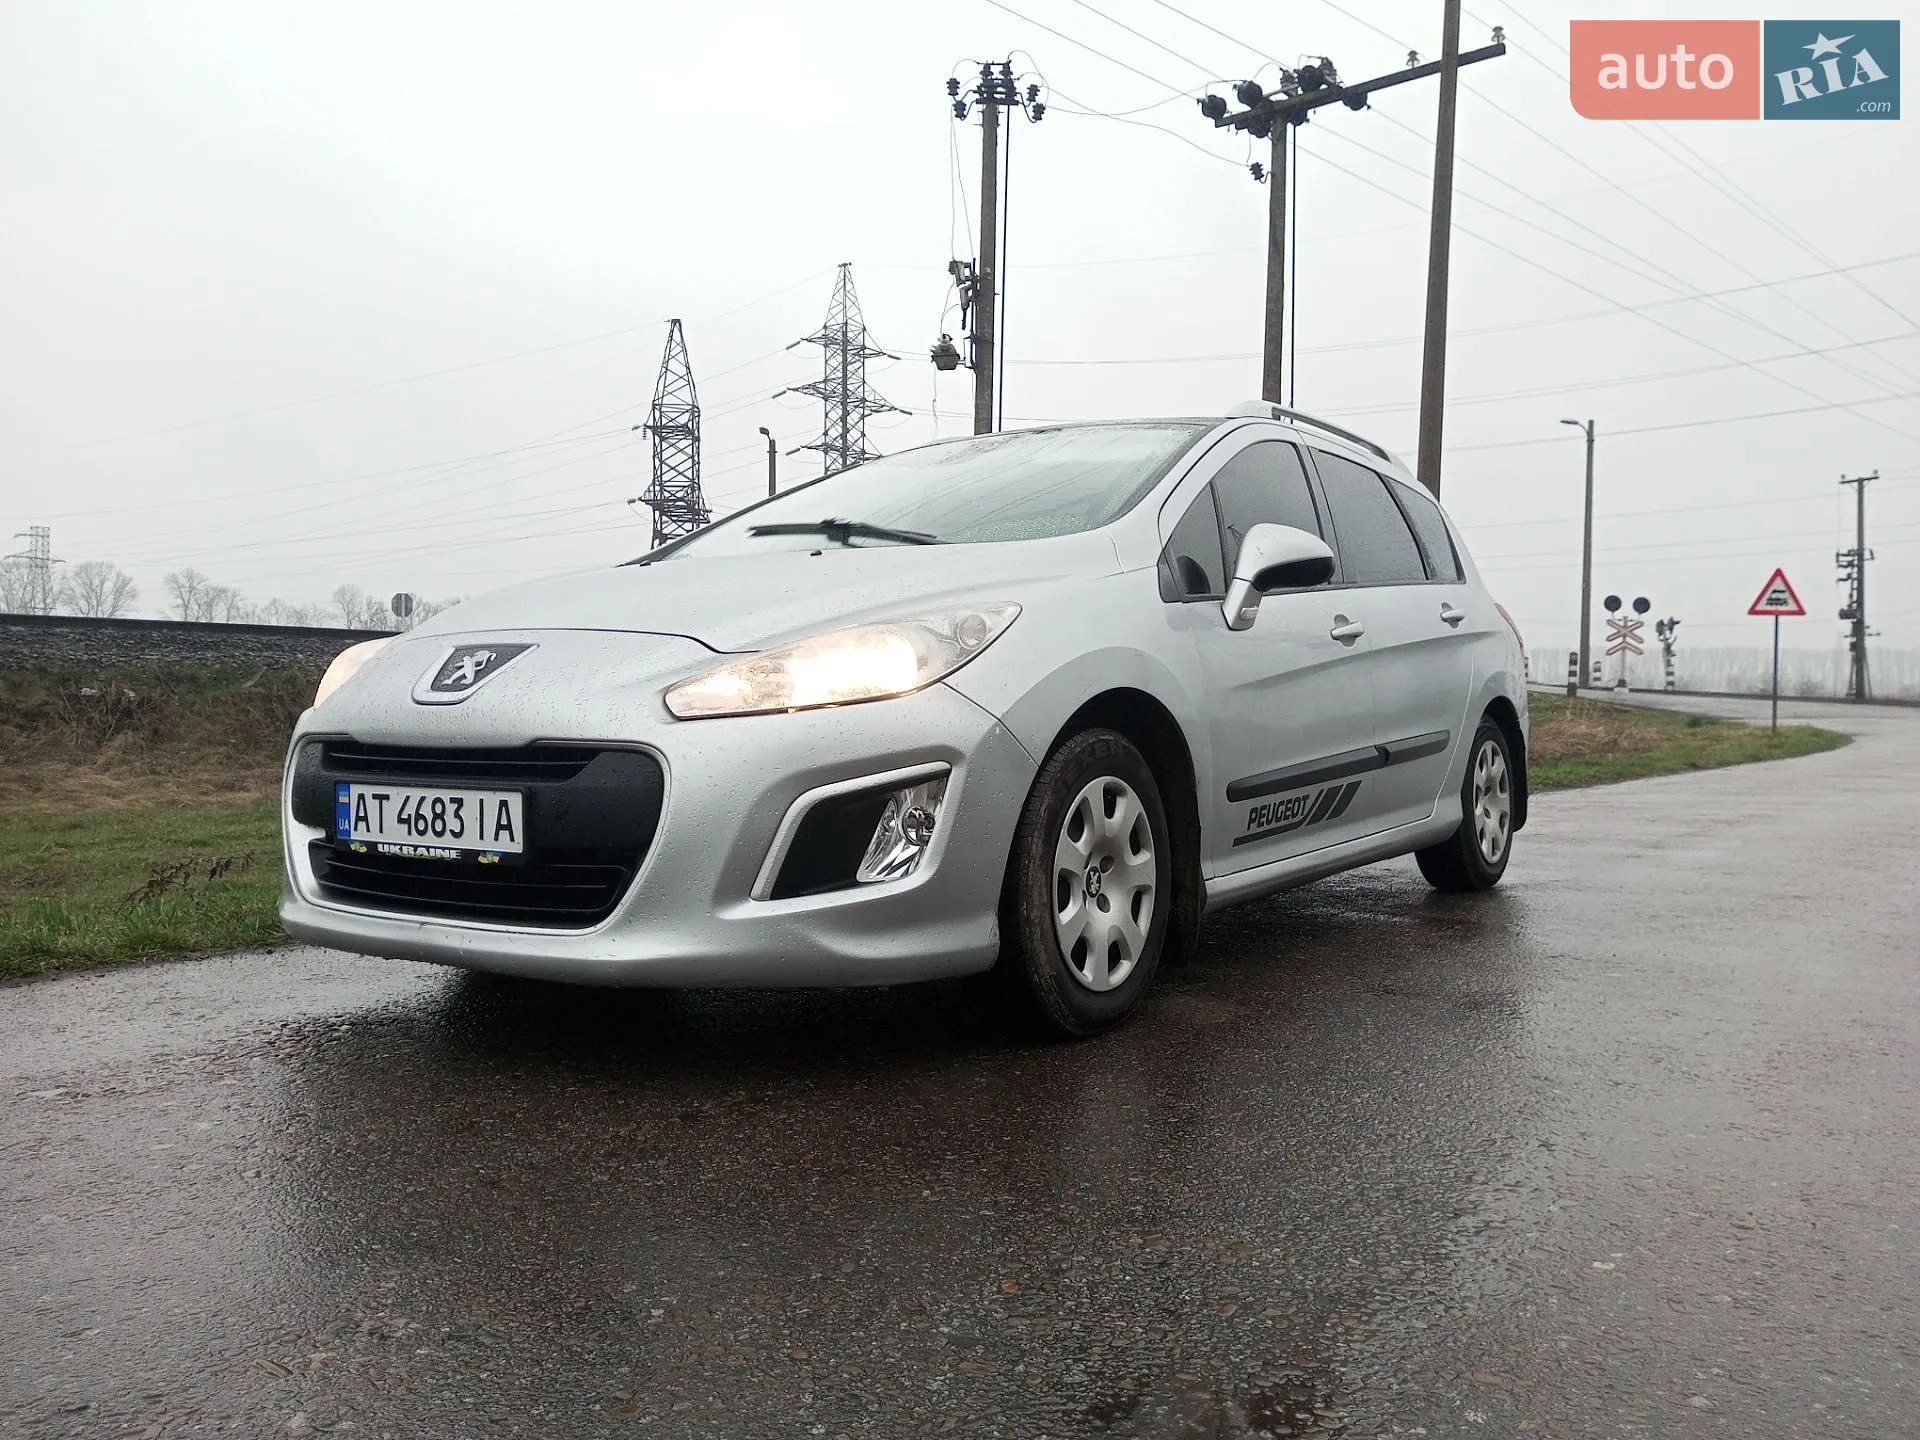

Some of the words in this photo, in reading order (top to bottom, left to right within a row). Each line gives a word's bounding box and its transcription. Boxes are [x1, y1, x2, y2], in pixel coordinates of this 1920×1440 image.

[338, 818, 350, 831] UA
[353, 792, 391, 834] AT
[396, 794, 465, 839] 4683
[478, 798, 516, 843] IA
[1246, 794, 1310, 832] PEUGEOT
[376, 843, 463, 860] UKRAINE
